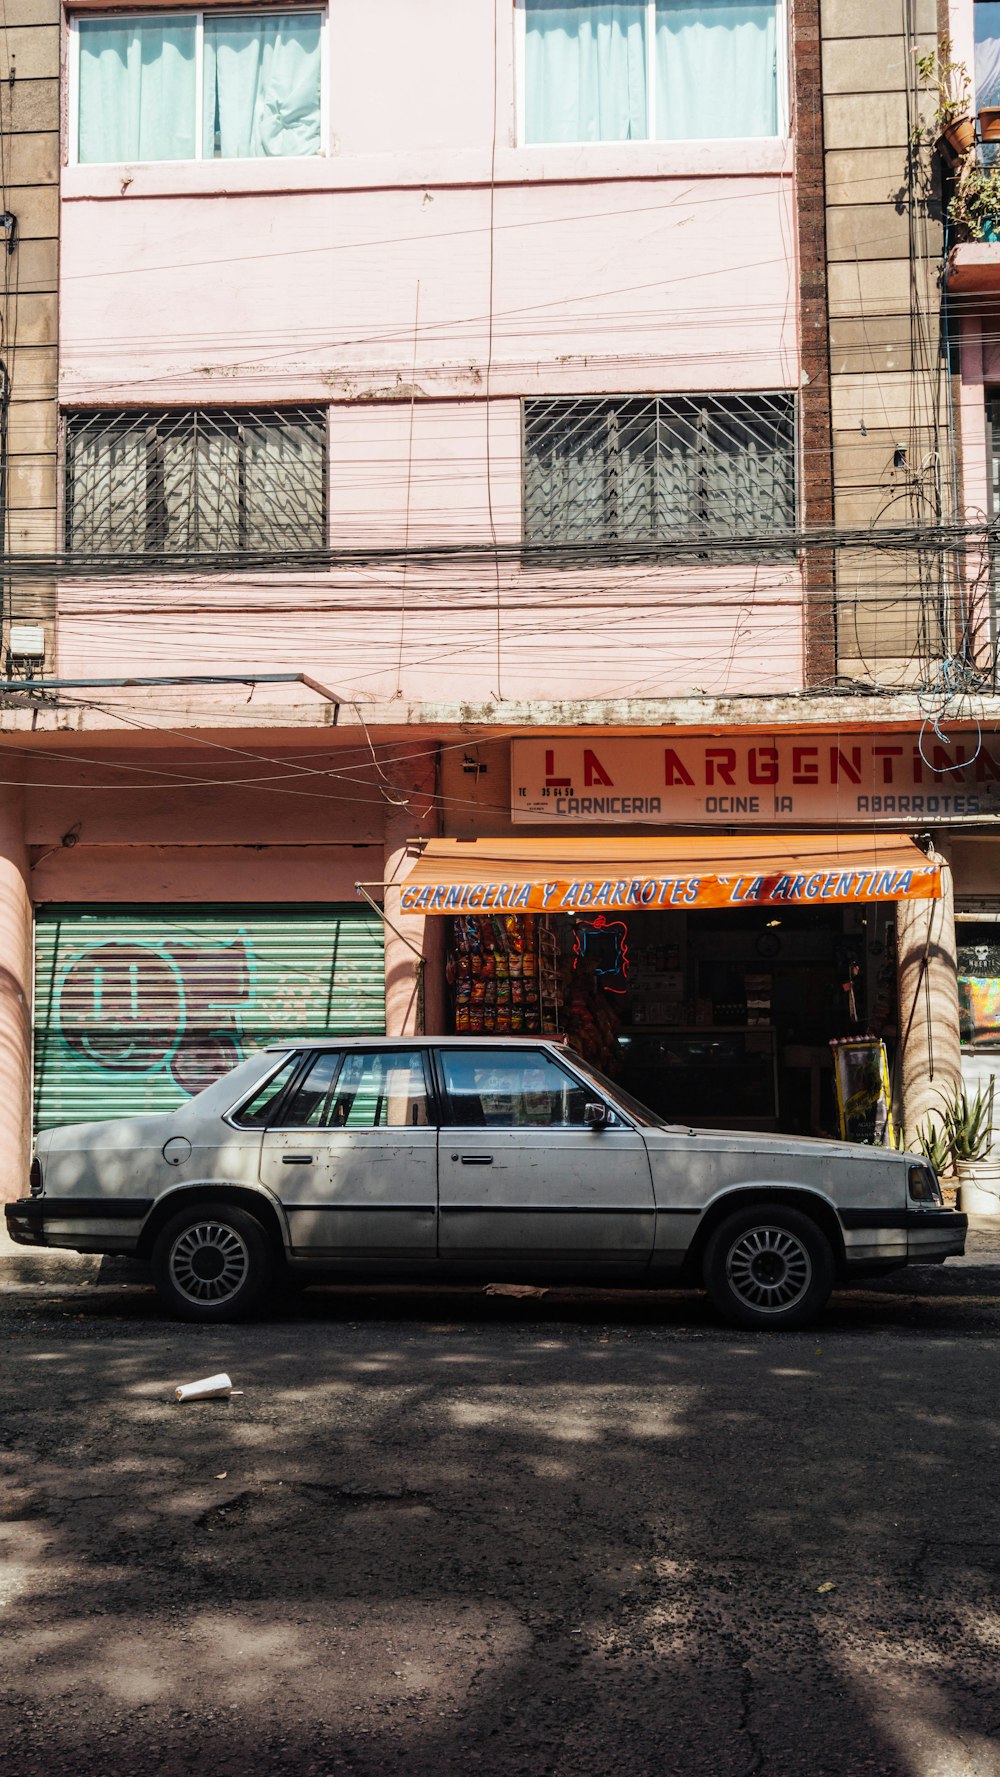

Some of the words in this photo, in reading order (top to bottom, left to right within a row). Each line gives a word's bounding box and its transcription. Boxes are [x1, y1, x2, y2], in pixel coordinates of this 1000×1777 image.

[546, 749, 614, 787] LA
[664, 745, 1000, 786] ARGENTINA
[556, 797, 661, 814] CARNICERIA
[705, 796, 760, 813] OCINE
[857, 795, 979, 813] ABARROTES
[400, 882, 533, 910] CARNICERIA
[542, 883, 558, 908] Y
[560, 878, 700, 908] ABARROTES
